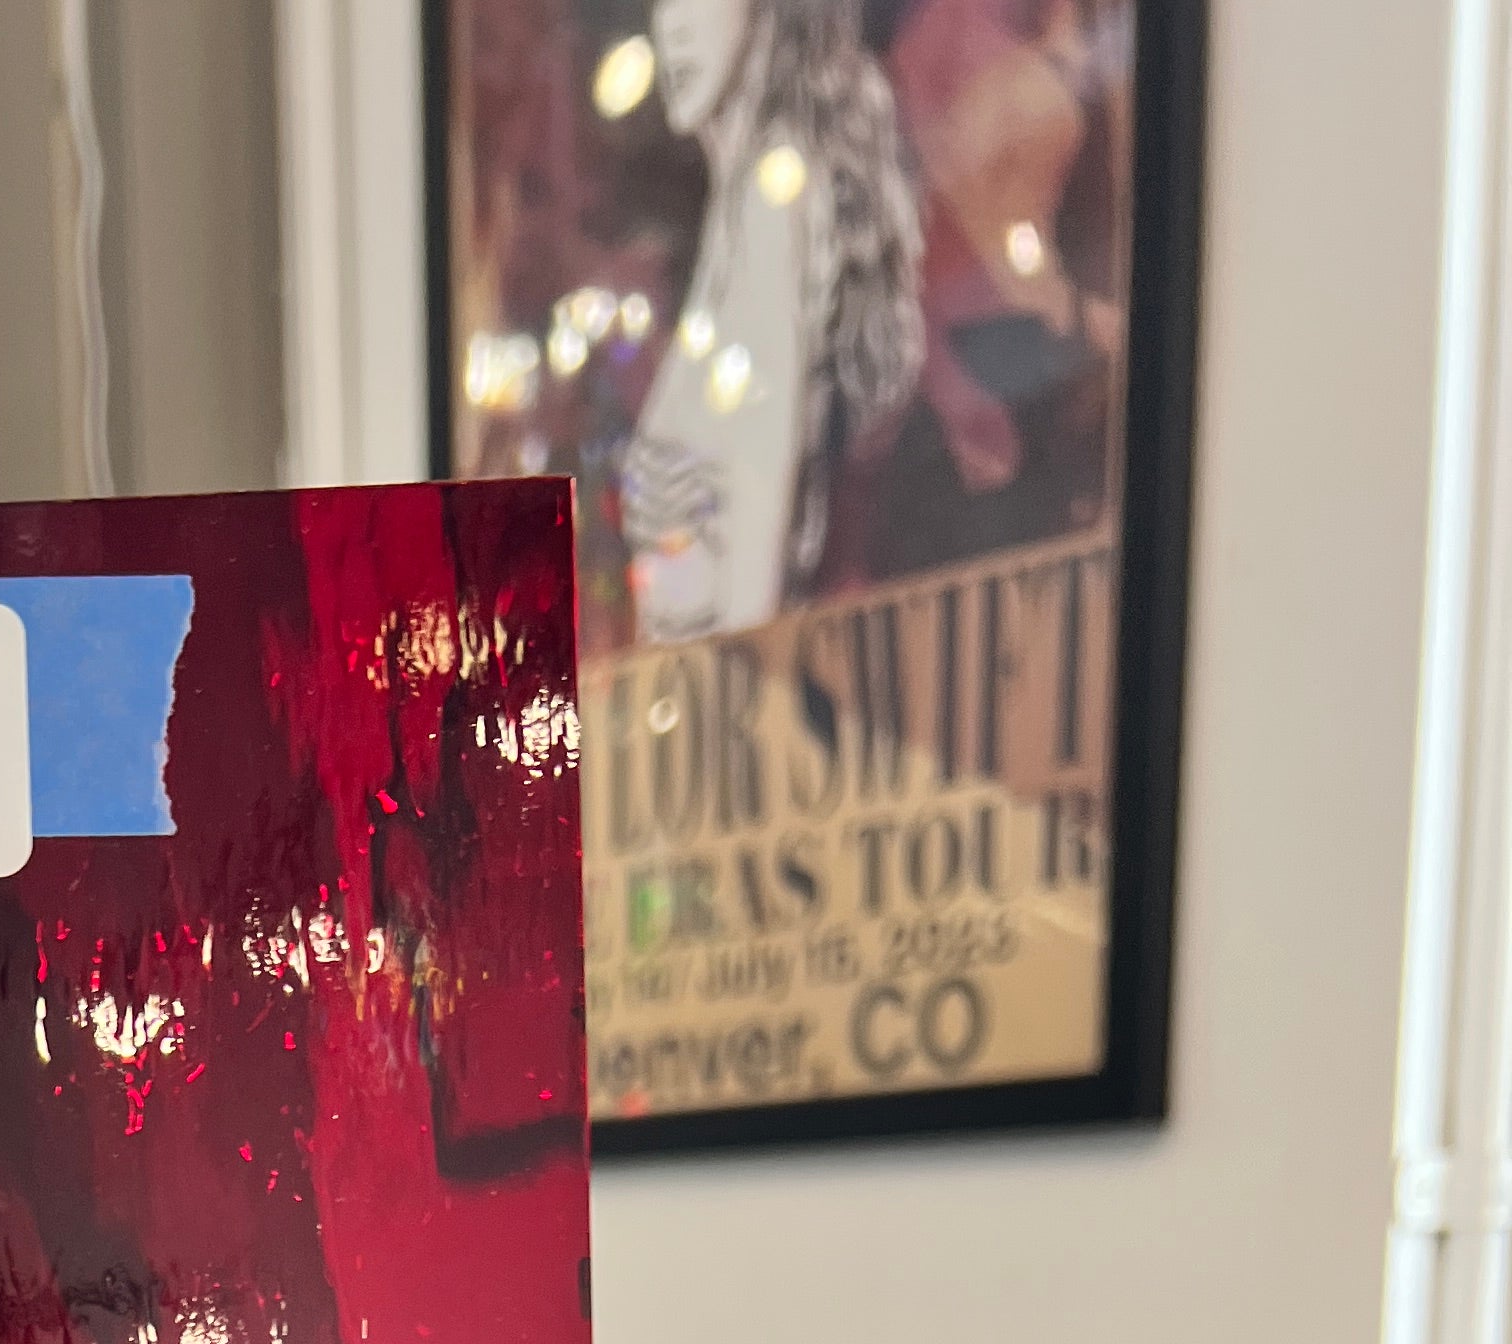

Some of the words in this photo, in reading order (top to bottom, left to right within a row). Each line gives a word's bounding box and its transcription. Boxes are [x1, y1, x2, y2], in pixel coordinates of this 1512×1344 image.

[790, 545, 1118, 816] SWIFT
[855, 788, 1106, 917] TOUR
[592, 1012, 836, 1090] enver,
[850, 973, 993, 1078] CO
